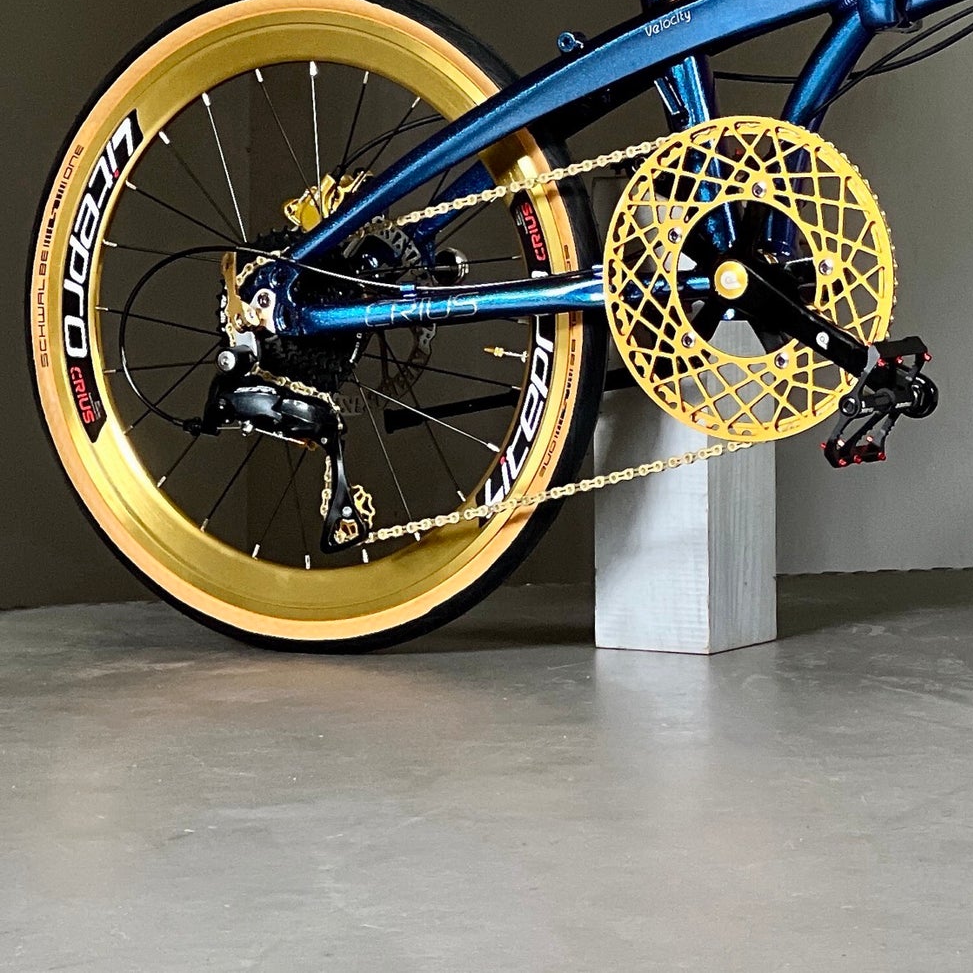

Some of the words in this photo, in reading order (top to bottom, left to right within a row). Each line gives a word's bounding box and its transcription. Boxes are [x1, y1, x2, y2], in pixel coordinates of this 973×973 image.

[645, 10, 691, 37] Velocity
[63, 117, 134, 358] Litepro
[521, 202, 547, 262] CRIUS
[37, 250, 49, 368] SCHWALBE
[365, 292, 479, 327] CRIUS
[70, 366, 95, 425] CRIUS
[483, 270, 554, 518] Litepr
